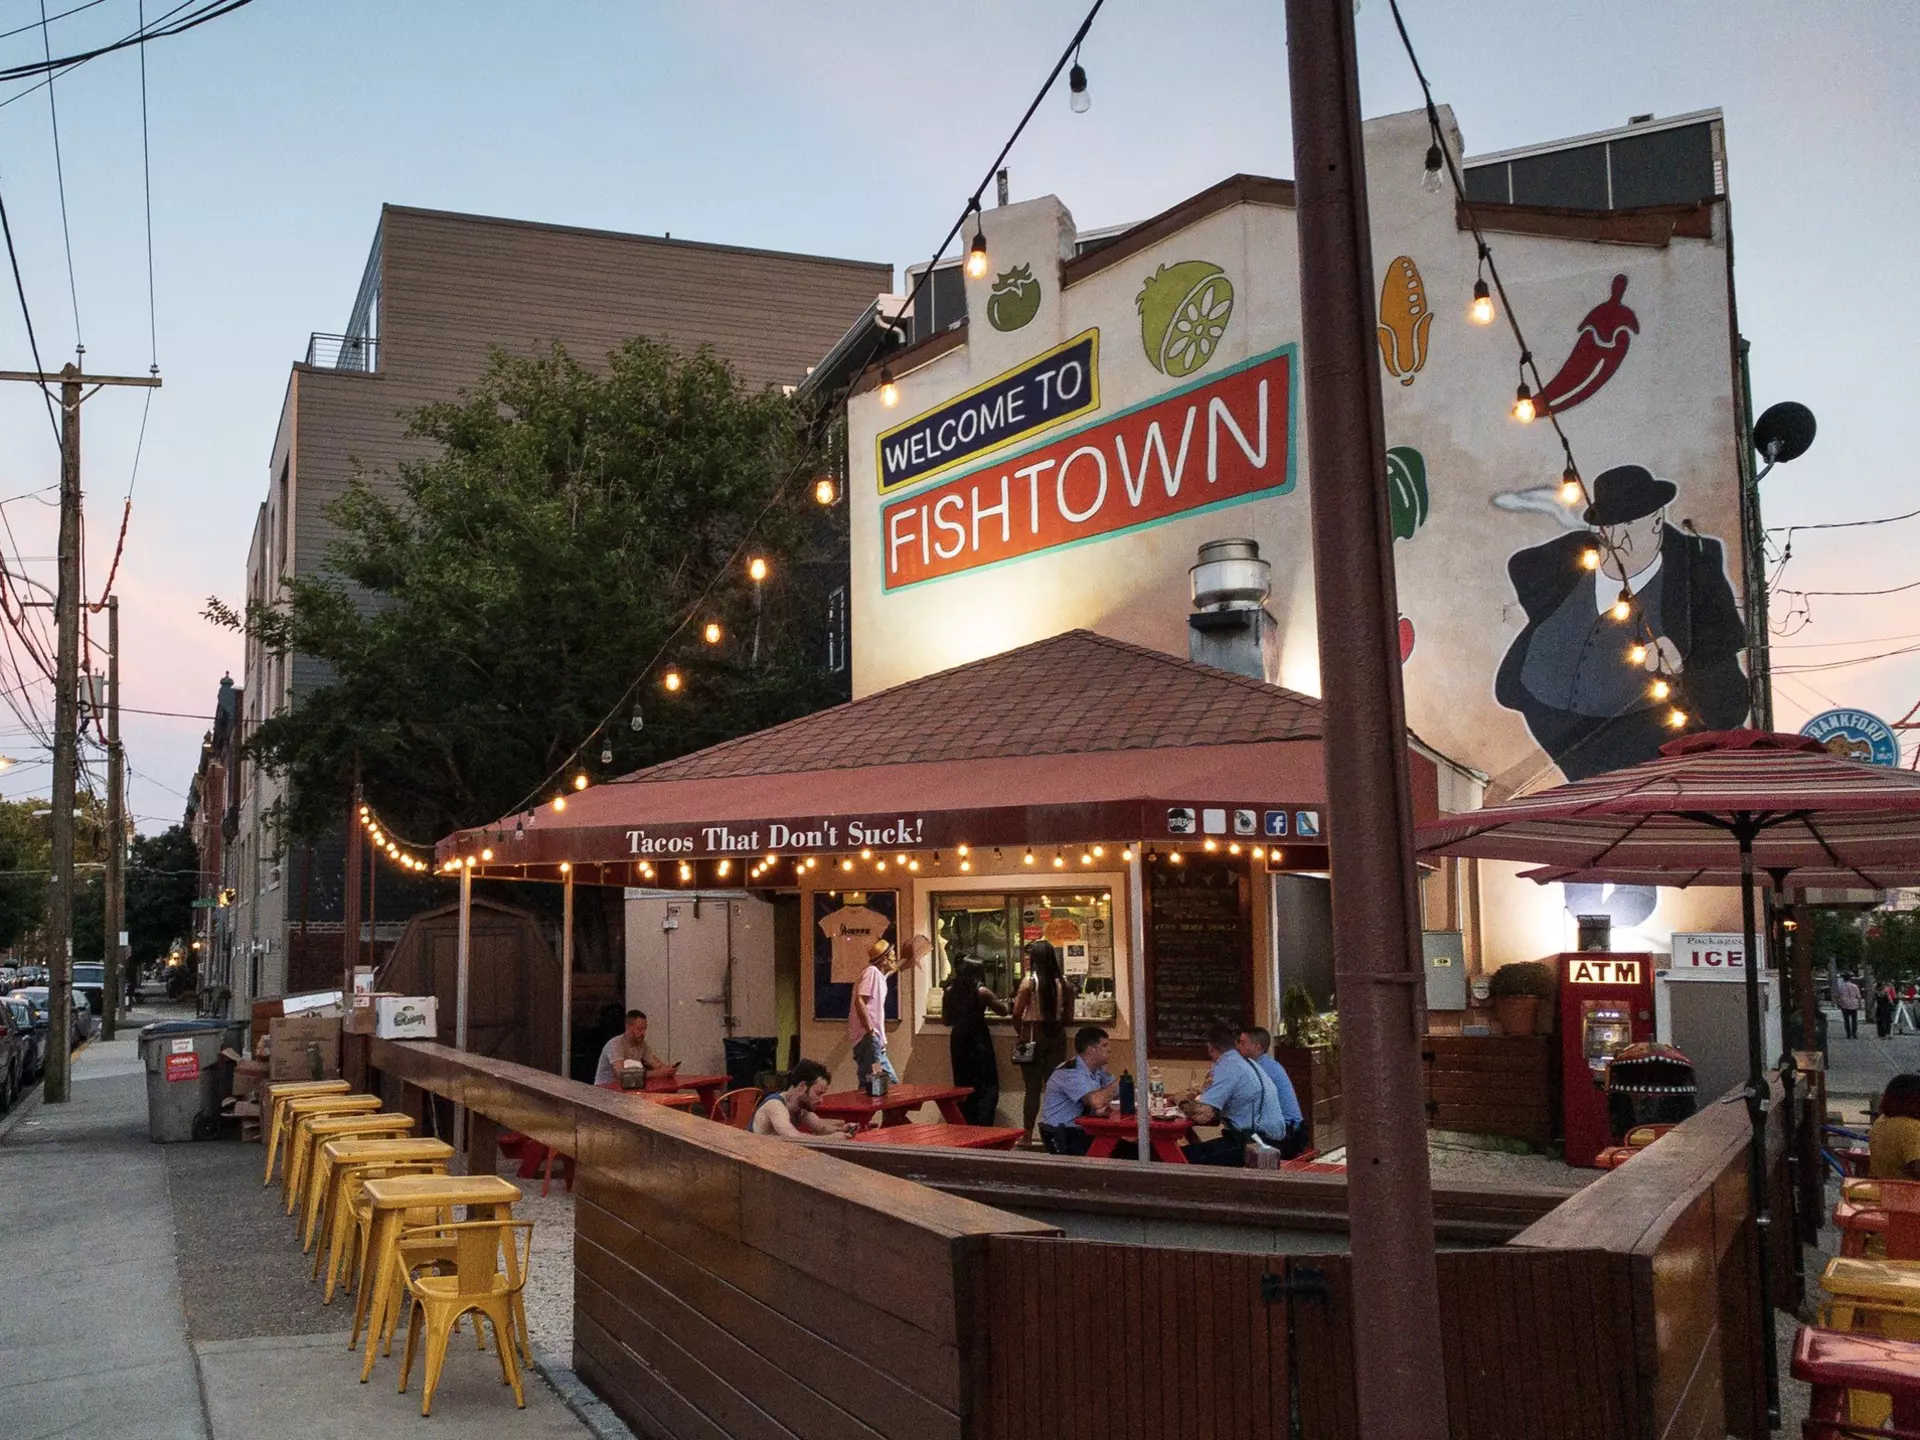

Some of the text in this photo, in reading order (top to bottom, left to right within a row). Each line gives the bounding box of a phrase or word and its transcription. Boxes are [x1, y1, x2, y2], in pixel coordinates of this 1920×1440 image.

[885, 360, 1083, 473] WELCOME TO
[889, 379, 1269, 574] FISHTOWN
[1806, 713, 1888, 742] RANKFORD
[626, 818, 923, 853] Tacos That Don't Suck!
[1575, 962, 1635, 982] ATM
[1692, 950, 1743, 967] ICE
